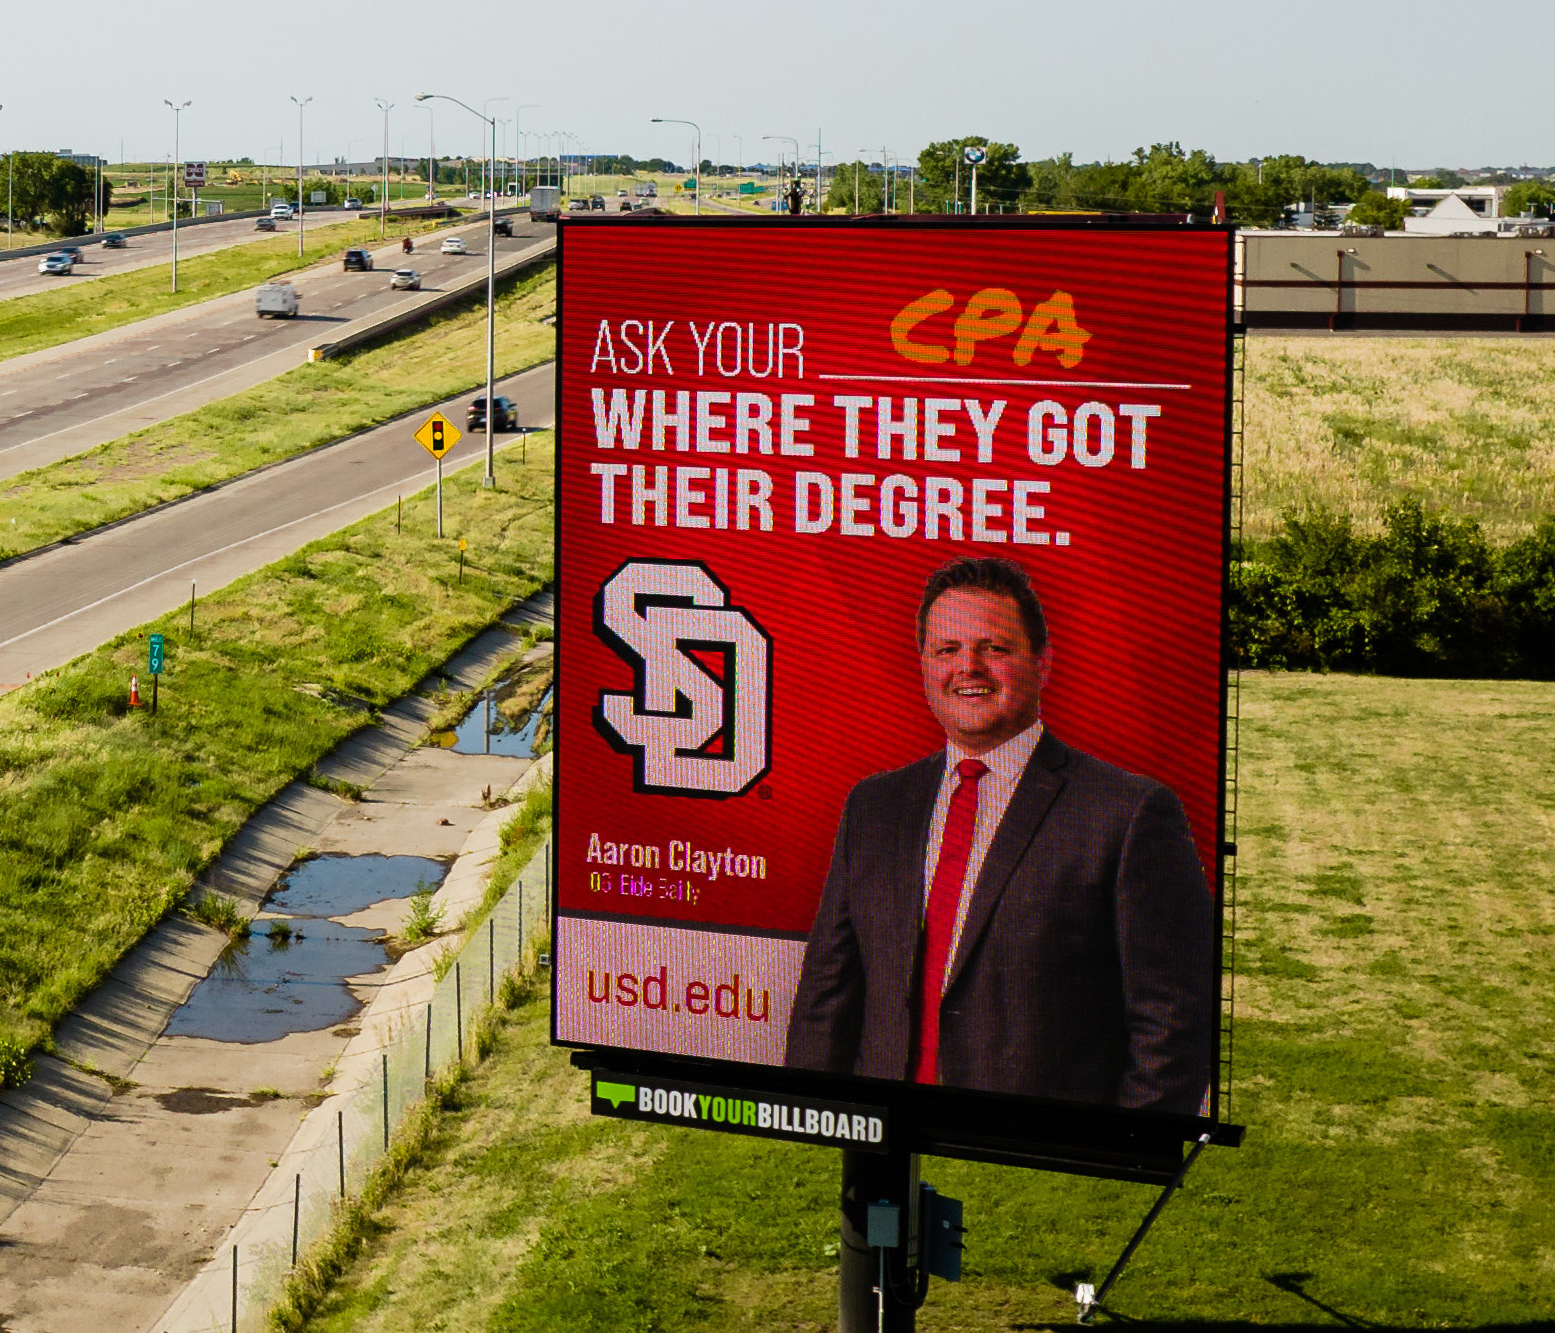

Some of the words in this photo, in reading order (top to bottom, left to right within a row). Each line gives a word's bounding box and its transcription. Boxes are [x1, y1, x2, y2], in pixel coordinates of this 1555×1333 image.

[590, 319, 675, 376] ASK
[689, 321, 804, 379] YOUR
[889, 287, 1093, 370] CPA
[590, 387, 816, 458] WHERE
[832, 394, 1008, 464] THEY
[1027, 399, 1162, 470] GOT
[589, 462, 774, 532] THEIR
[794, 470, 1071, 546] DEGREE.
[151, 644, 160, 671] 79
[586, 832, 660, 869] Aaron
[668, 839, 767, 882] Clayton
[586, 965, 771, 1023] usd.edu
[638, 1086, 883, 1144] BOOKYOURBILLBOARD
